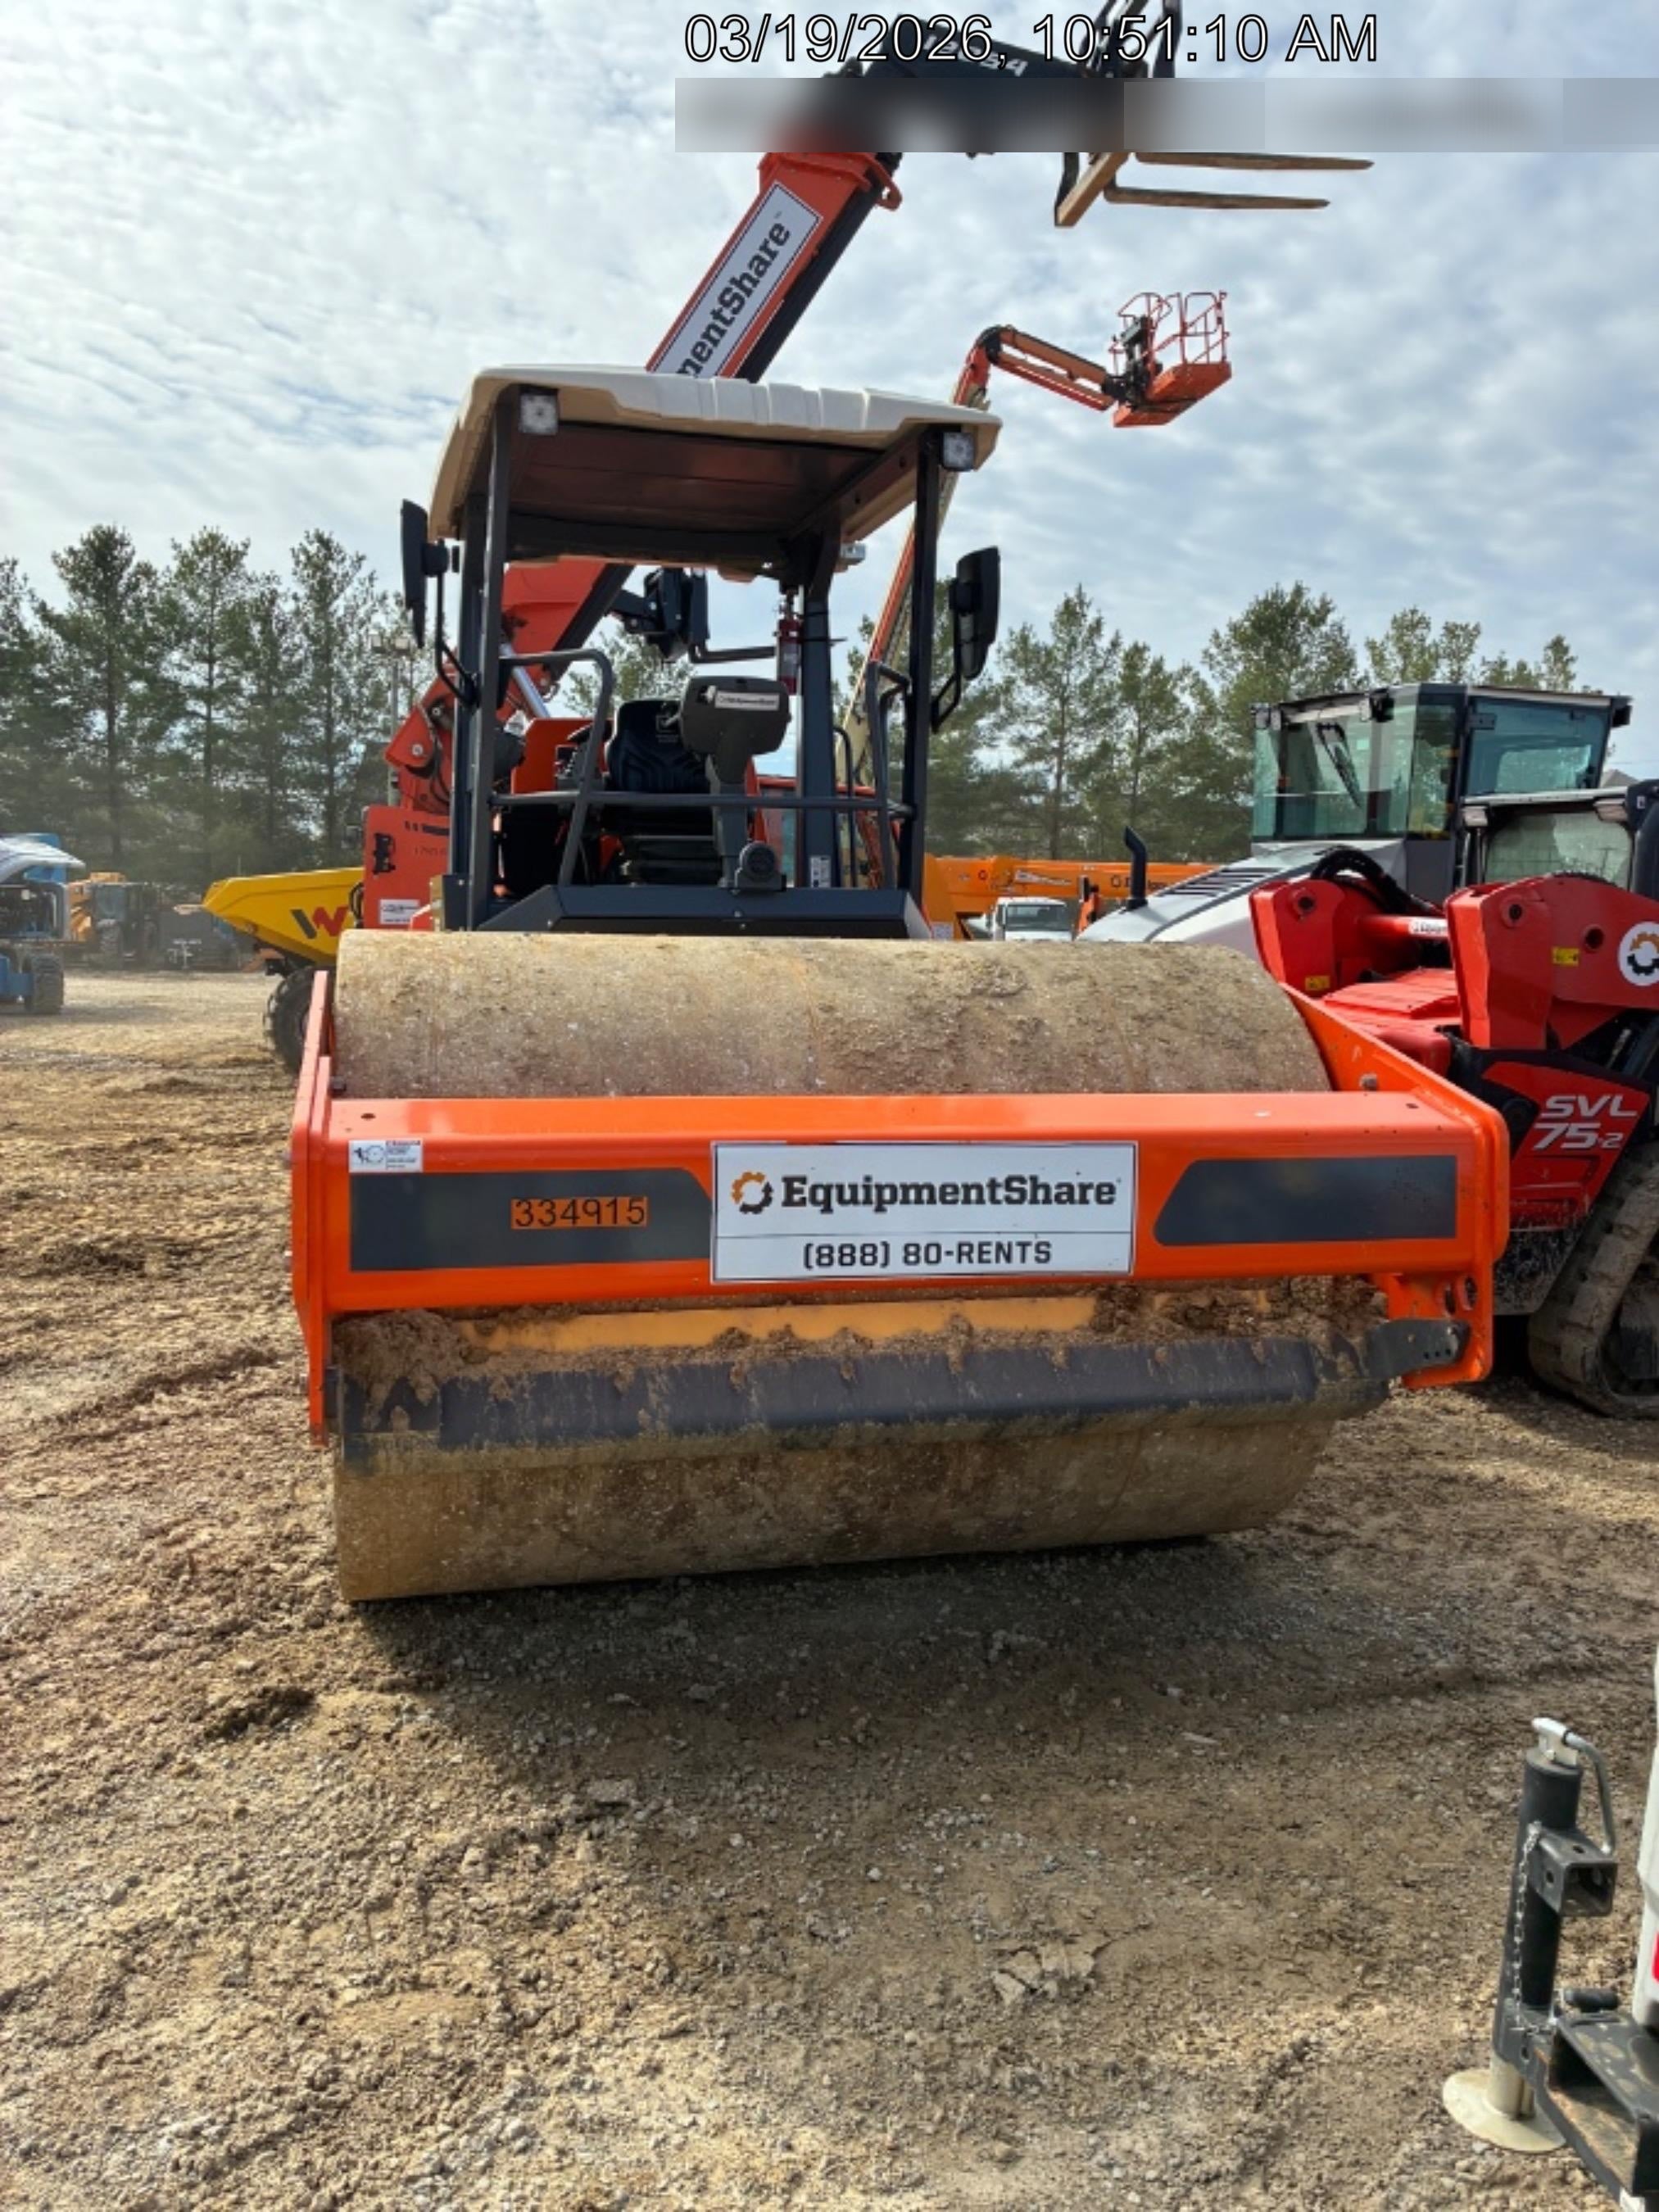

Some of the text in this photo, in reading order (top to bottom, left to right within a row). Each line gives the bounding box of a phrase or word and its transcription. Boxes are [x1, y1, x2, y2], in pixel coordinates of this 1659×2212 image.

[1540, 1095, 1638, 1117] SVL
[781, 1175, 1117, 1214] EquipmentShare
[515, 1198, 645, 1227] 334915
[804, 1240, 1052, 1270] (888) 80-RENTS
